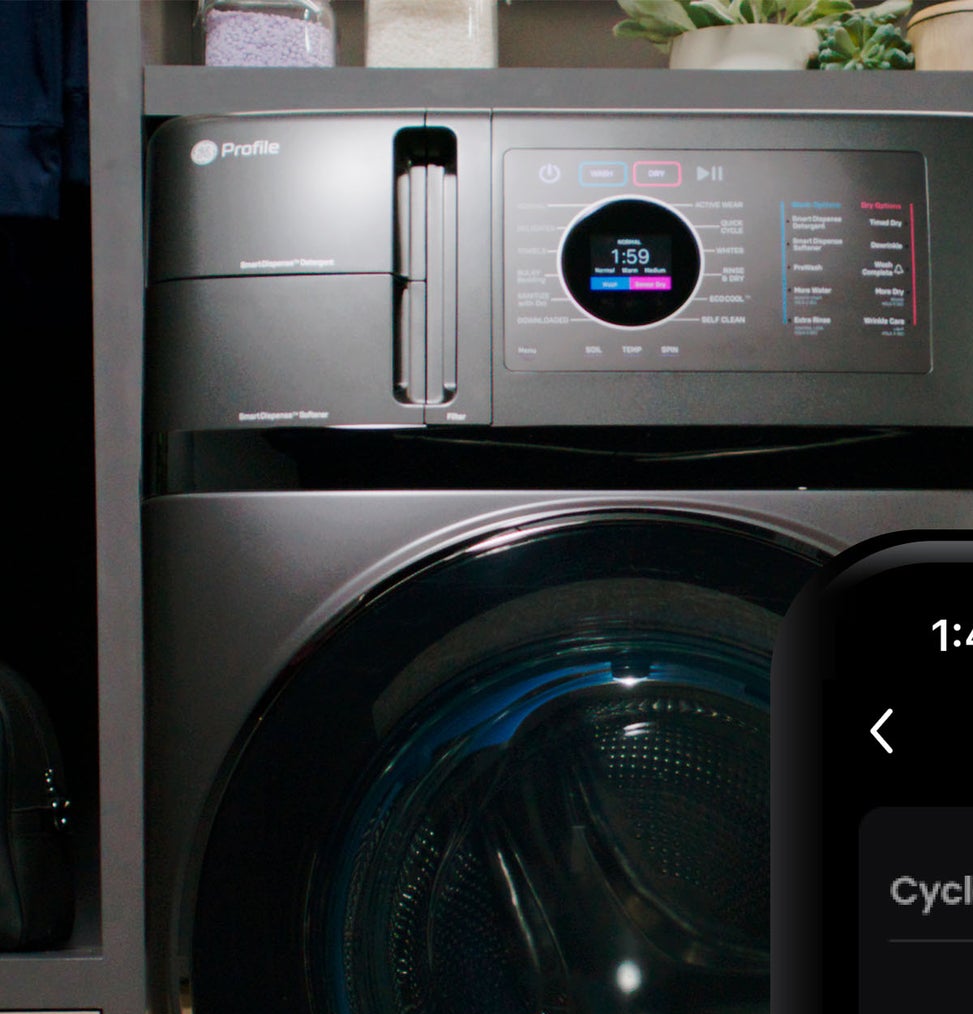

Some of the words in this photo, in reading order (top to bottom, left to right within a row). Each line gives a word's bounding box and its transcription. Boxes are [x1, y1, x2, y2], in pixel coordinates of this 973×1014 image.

[221, 140, 281, 158] Profile
[589, 169, 614, 178] WASH
[647, 169, 666, 178] DRY
[694, 201, 720, 209] ACTIVE
[721, 201, 744, 209] WEAR
[860, 201, 874, 210] Dry
[874, 202, 902, 210] Options
[720, 219, 743, 227] QUICK
[869, 218, 890, 227] Timed
[890, 218, 903, 228] Dry
[720, 227, 744, 235] CYCLE
[617, 238, 642, 246] NORMAL
[870, 240, 904, 250] Dewrinkle
[716, 247, 744, 255] WHITES
[611, 248, 650, 265] 1:59
[793, 263, 824, 272] PreWash
[873, 260, 894, 269] Wash
[722, 267, 744, 275] RINSE
[861, 268, 894, 278] Complete
[729, 275, 744, 283] DRY
[655, 281, 667, 289] Dry
[793, 286, 811, 294] More
[811, 286, 833, 294] Water
[874, 287, 892, 296] More
[892, 287, 905, 297] Dry
[701, 316, 719, 324] SELF
[720, 316, 746, 324] CLEAN
[793, 316, 812, 324] Extra
[812, 316, 832, 324] Rinse
[863, 316, 889, 325] Wrinkle
[889, 317, 906, 325] Care
[517, 346, 537, 354] Menu
[585, 346, 602, 354] SOIL
[622, 345, 642, 354] TEMP
[660, 345, 679, 354] SPIN
[299, 410, 329, 419] Softener
[446, 411, 467, 421] Filter
